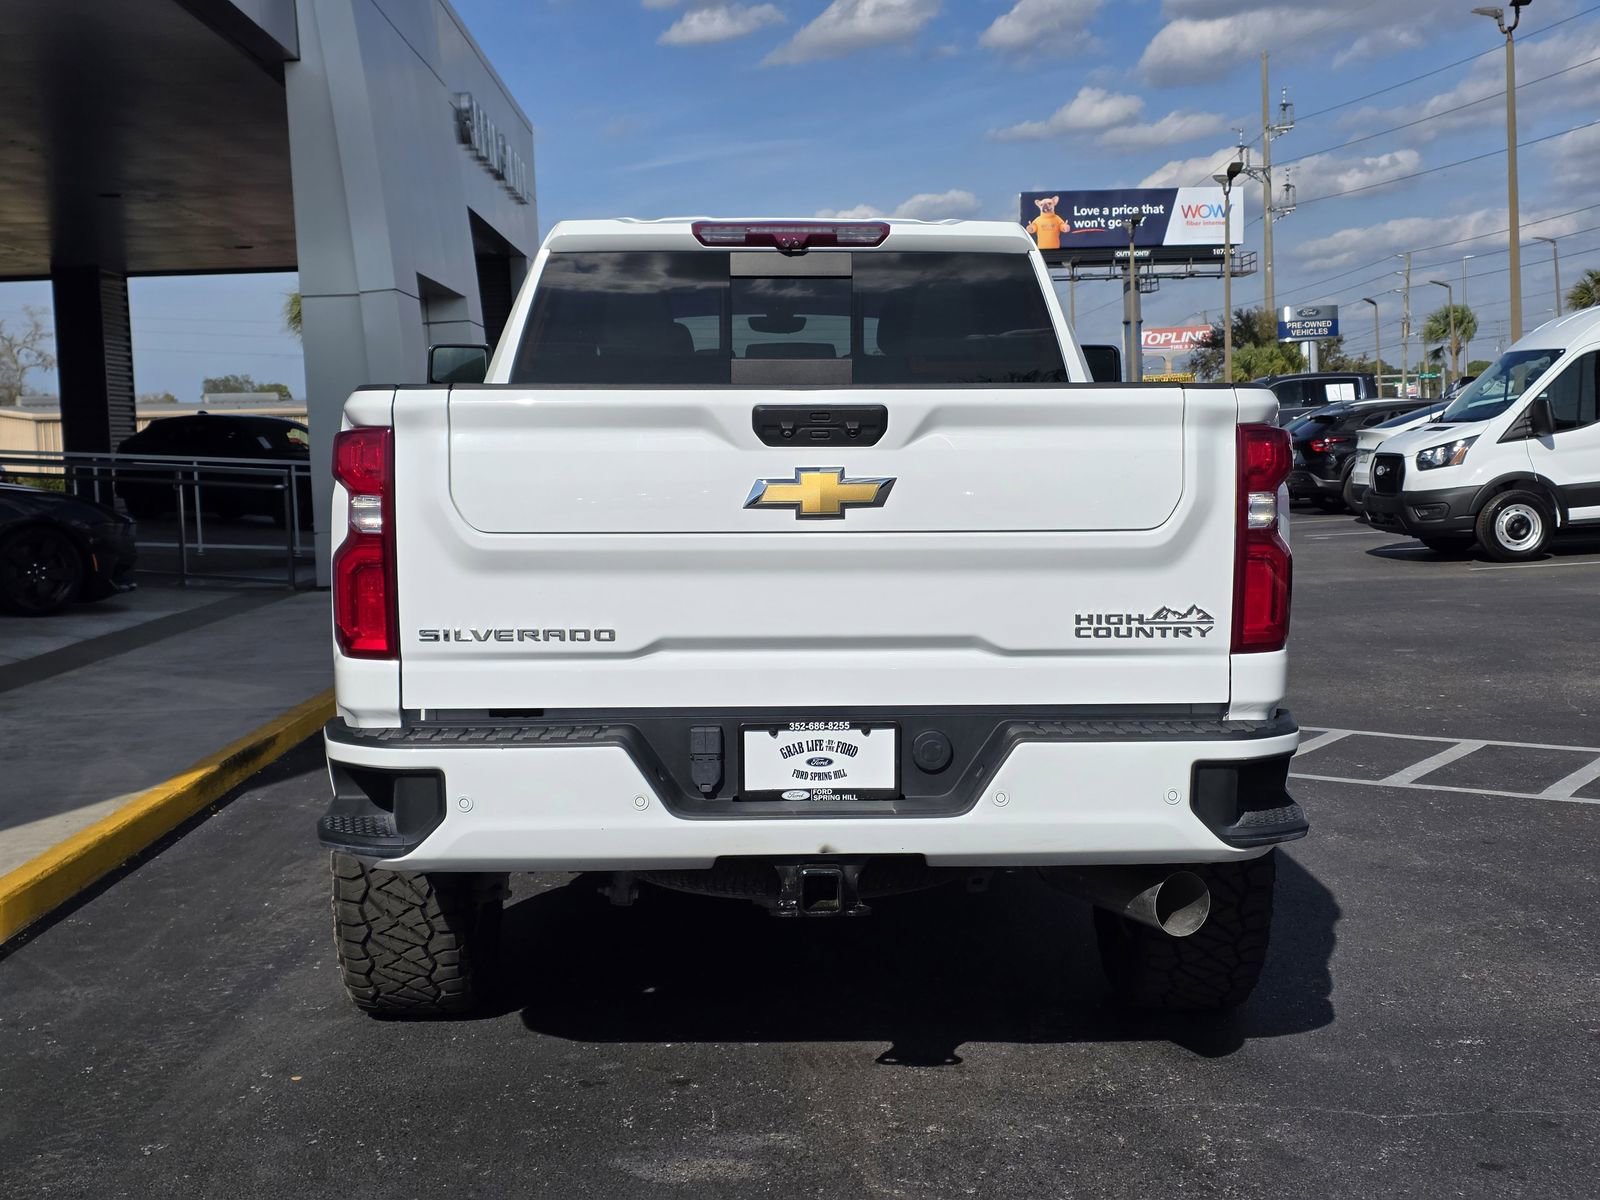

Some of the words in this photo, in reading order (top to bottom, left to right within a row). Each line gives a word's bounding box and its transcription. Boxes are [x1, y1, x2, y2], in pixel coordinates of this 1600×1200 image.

[1073, 205, 1100, 216] Love
[1102, 207, 1110, 215] a
[1112, 204, 1139, 217] price
[1141, 203, 1165, 214] that
[1073, 217, 1106, 228] won't
[1286, 320, 1332, 329] PRE-OWNED
[1291, 328, 1329, 336] VEHICLES
[1074, 613, 1145, 626] HIGH
[418, 628, 616, 642] SILVERADO
[1074, 626, 1214, 639] COUNTRY
[789, 721, 850, 731] 352-686-8255
[779, 742, 805, 760] GRAB
[805, 739, 825, 752] LIFE
[835, 740, 859, 758] FORD
[810, 757, 829, 766] Ford
[791, 768, 809, 781] FORD
[809, 770, 833, 782] SPRING
[832, 768, 848, 780] HILL
[786, 791, 804, 799] Ford
